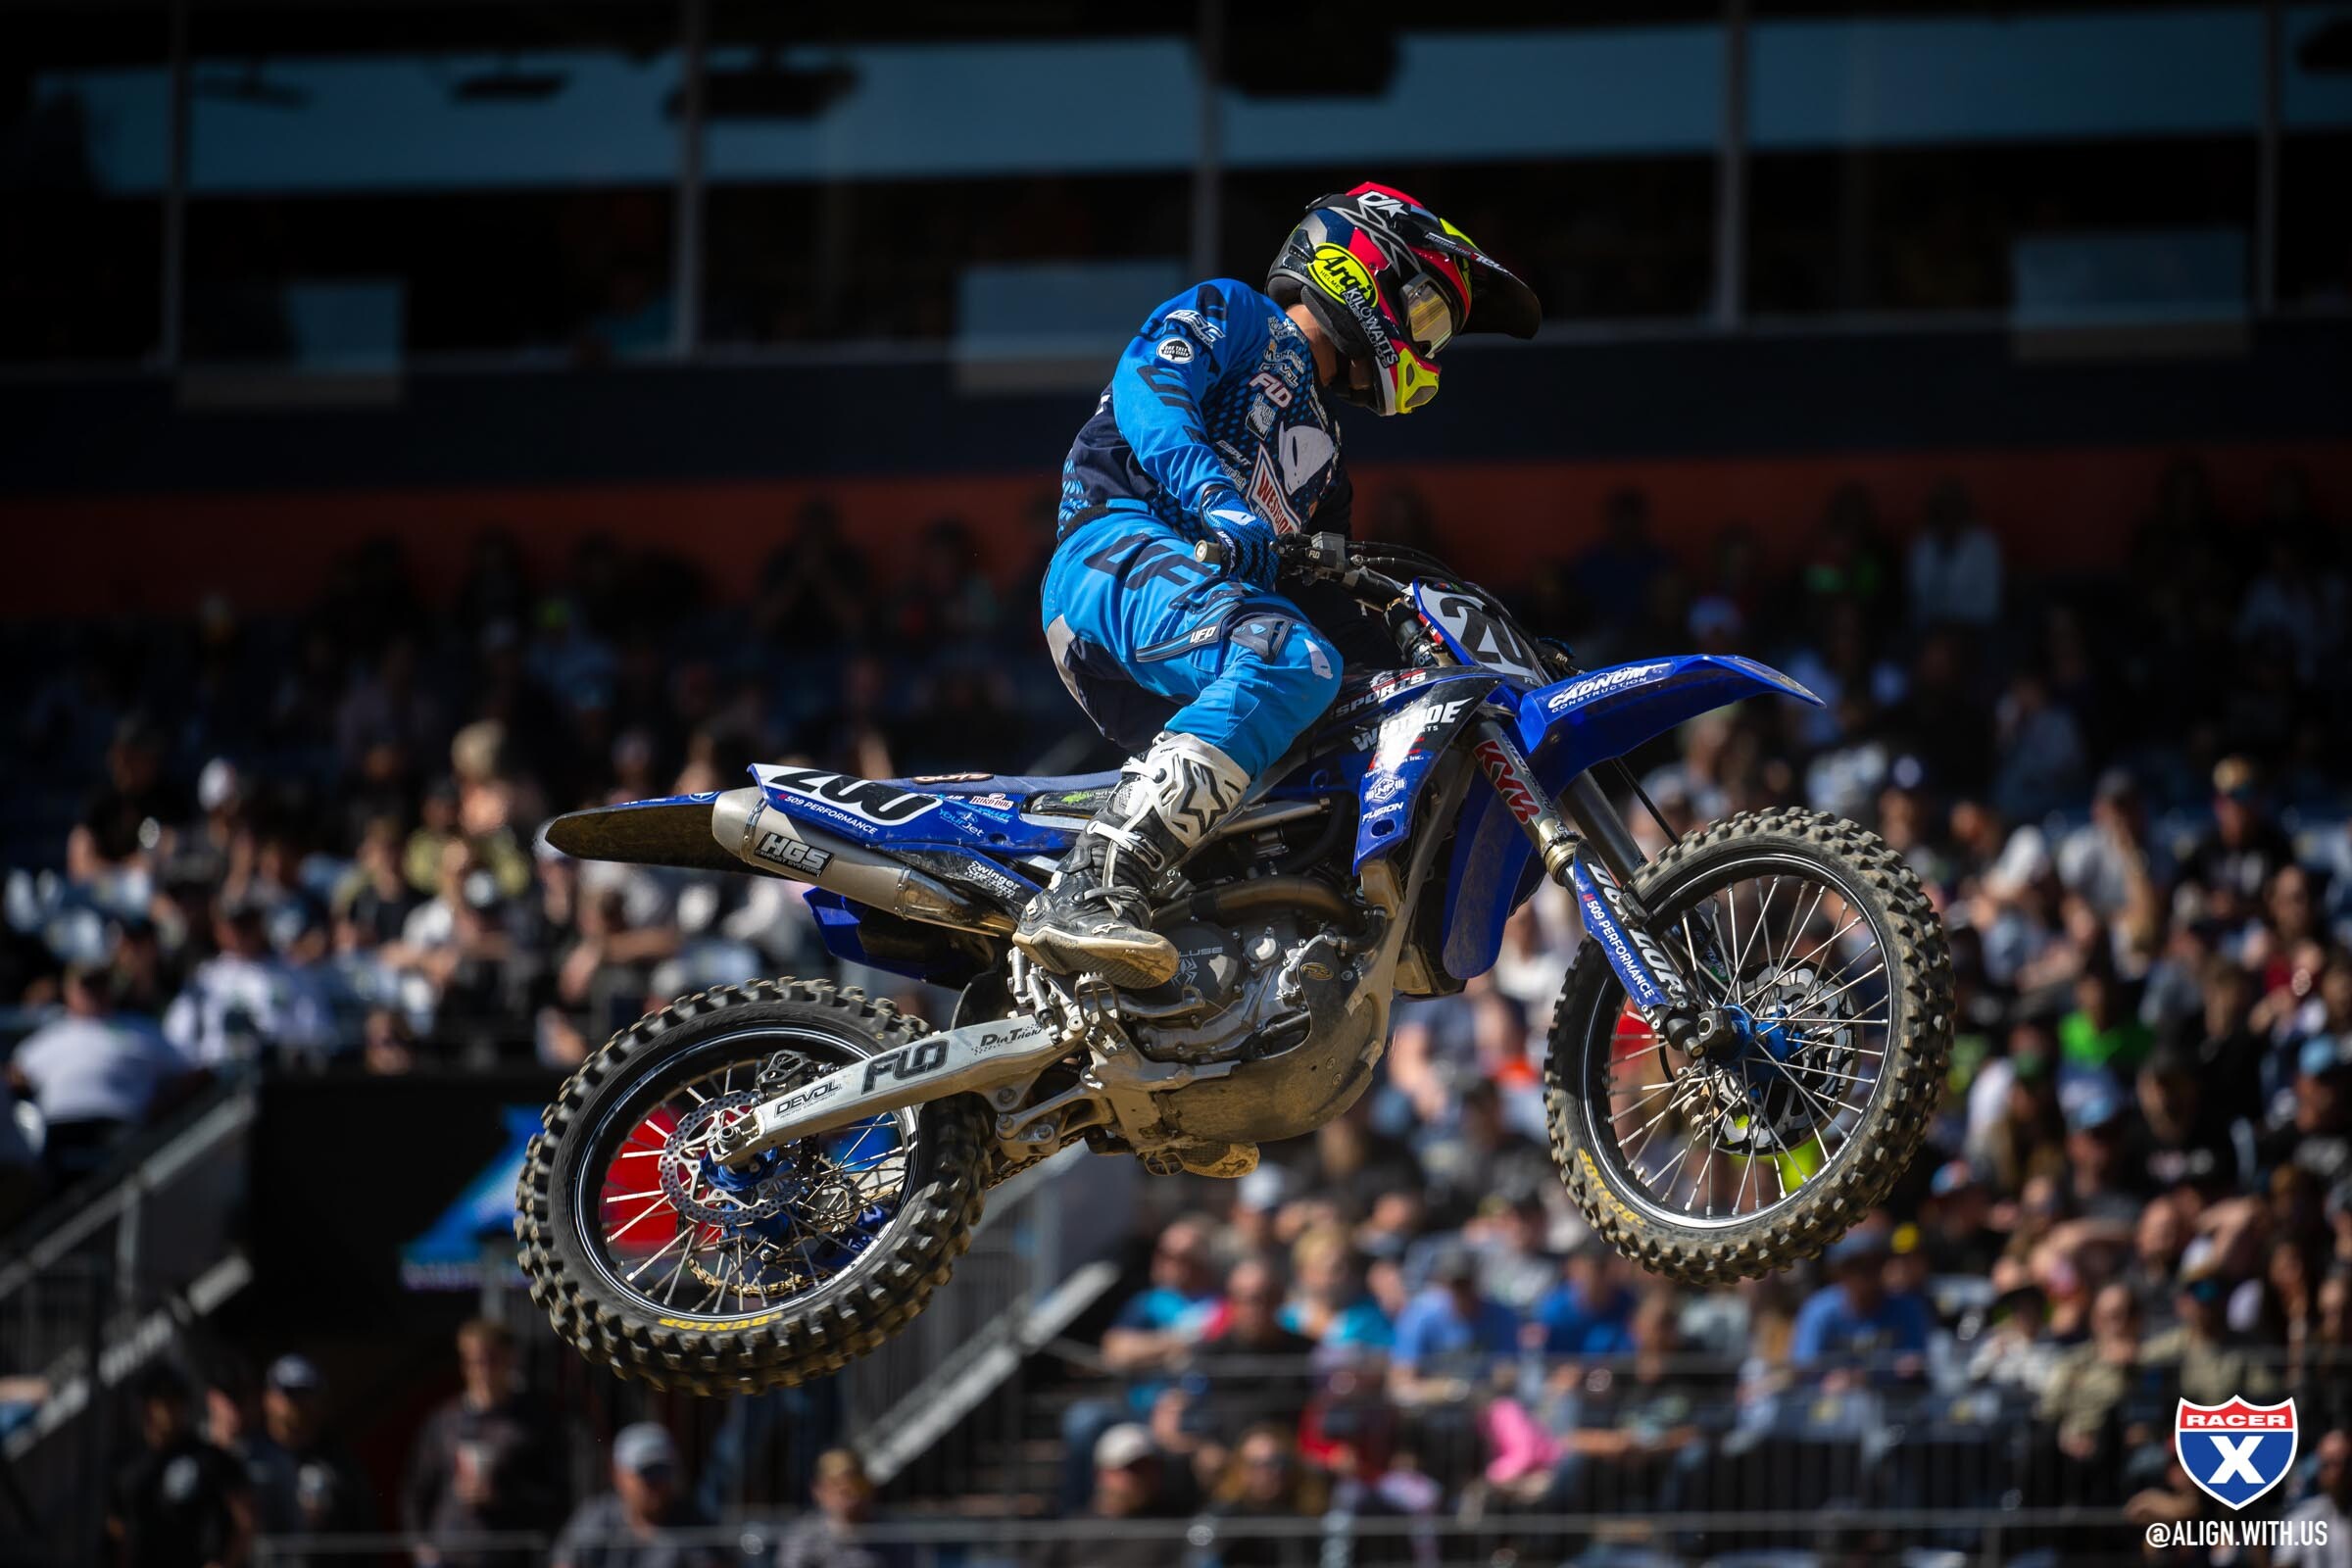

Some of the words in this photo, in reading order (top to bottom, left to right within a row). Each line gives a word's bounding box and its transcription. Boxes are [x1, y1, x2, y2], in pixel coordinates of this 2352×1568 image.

[1315, 256, 1374, 297] Arai
[1347, 287, 1399, 366] KILOWATTS
[1256, 466, 1294, 535] WESTSID
[1189, 626, 1217, 643] UFO
[1551, 676, 1647, 713] CONSTRUCTION
[768, 770, 938, 821] 200
[1473, 739, 1543, 825] KYB
[805, 802, 878, 835] PERFORMANCE
[939, 808, 985, 837] YourJet
[1362, 802, 1404, 825] FUSION
[761, 833, 831, 870] HGS
[967, 860, 1021, 890] Zwinger
[1587, 862, 1688, 996] DULOP
[1598, 920, 1655, 1000] PERFORMANCE
[861, 1039, 950, 1096] FLO
[774, 1081, 841, 1117] DEVOL
[659, 1315, 770, 1332] DUNLOP
